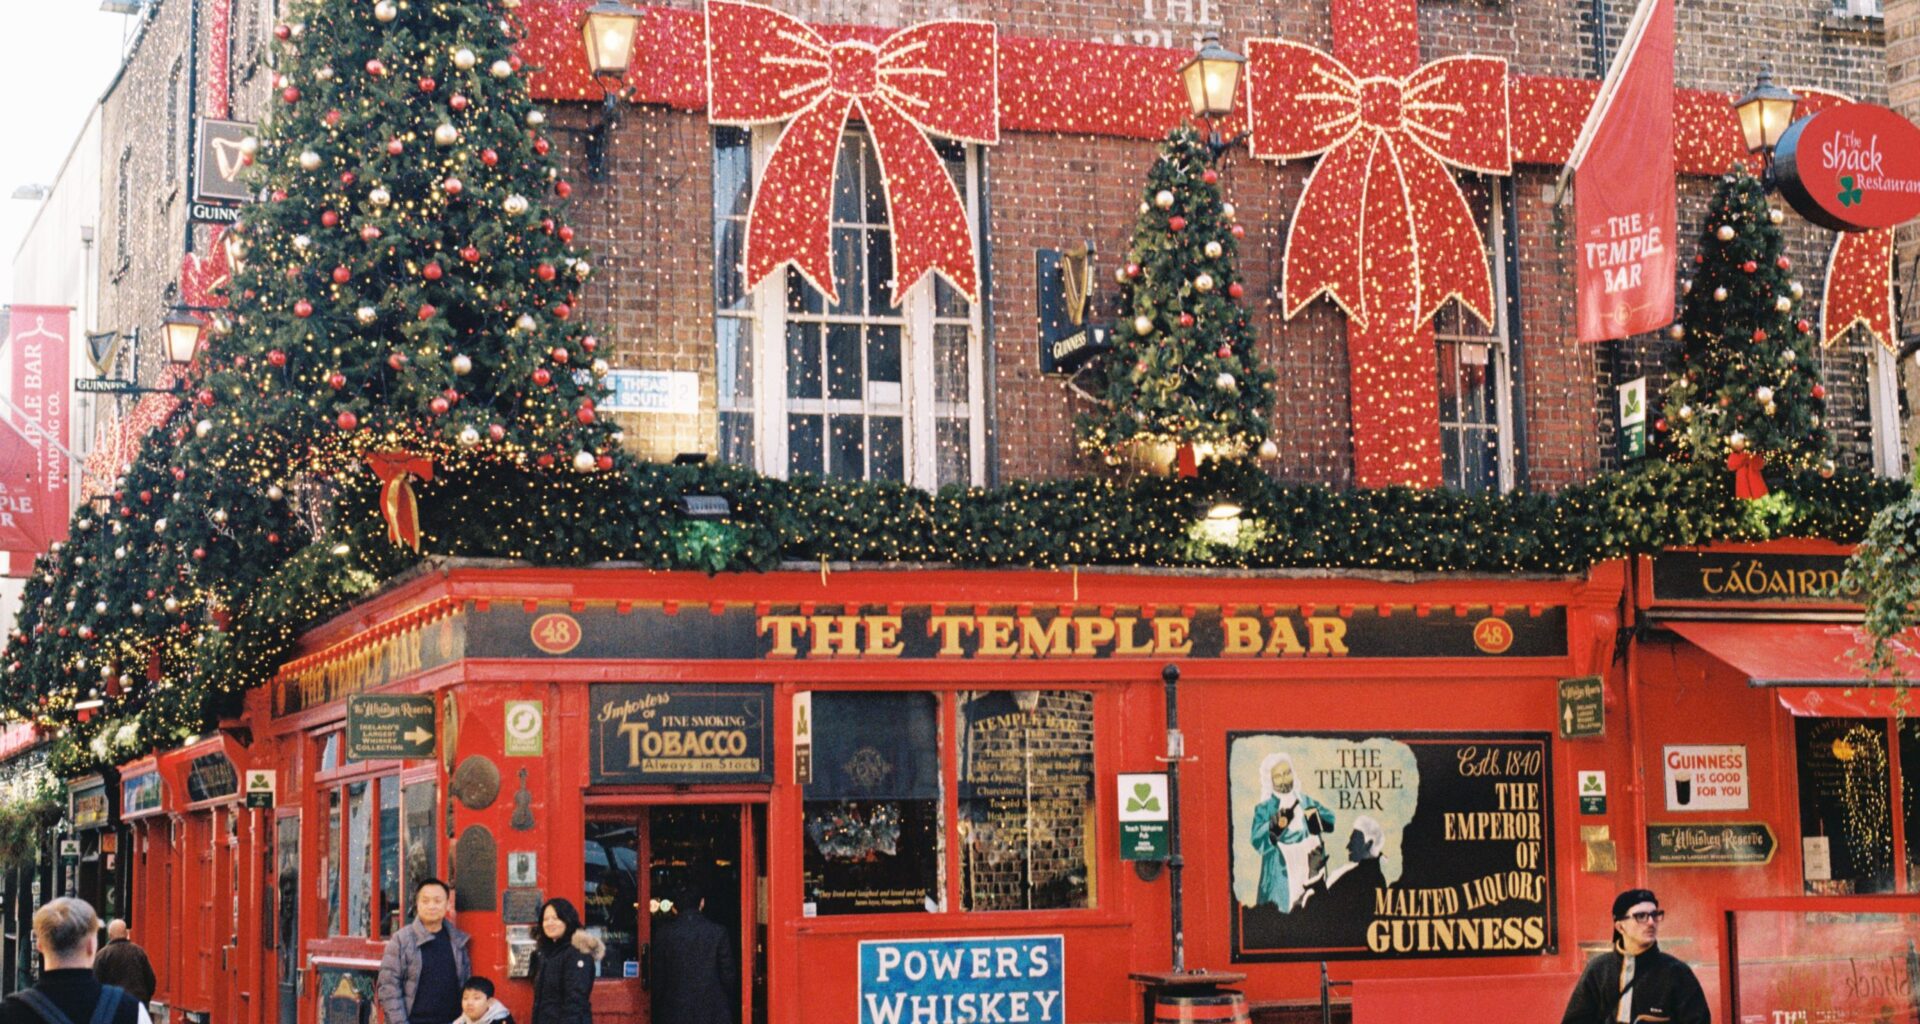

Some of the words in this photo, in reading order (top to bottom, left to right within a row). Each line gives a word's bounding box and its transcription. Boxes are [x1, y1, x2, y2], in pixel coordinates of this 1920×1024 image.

[1842, 130, 1861, 148] The
[1822, 130, 1884, 177] Shack
[1856, 173, 1920, 193] Restauran
[193, 204, 239, 220] GUINN
[1608, 213, 1642, 238] THE
[1585, 226, 1664, 269] TEMPLE
[1603, 263, 1641, 294] BAR
[24, 343, 42, 389] BAR
[541, 621, 569, 643] 48
[759, 616, 905, 656] THE
[929, 616, 1193, 656] TEMPLE
[1222, 617, 1349, 656] BAR
[1481, 625, 1503, 645] 48
[300, 667, 324, 709] THE
[330, 644, 382, 701] TEMPLE
[390, 630, 421, 677] BAR
[597, 692, 670, 722] Importers
[662, 716, 689, 727] FINE
[691, 716, 745, 727] SMOKING
[645, 759, 692, 771] Always
[701, 759, 712, 769] in
[720, 759, 757, 769] Stock
[1336, 749, 1382, 768] THE
[1506, 751, 1540, 776] 1840
[1667, 752, 1743, 769] GUINNESS
[1315, 770, 1403, 789] TEMPLE
[1696, 773, 1706, 783] IS
[1709, 773, 1740, 783] GOOD
[1340, 790, 1384, 811] BAR
[1495, 783, 1539, 810] THE
[1697, 786, 1716, 797] FOR
[1721, 786, 1741, 797] YOU
[1444, 812, 1541, 840] EMPEROR
[1658, 832, 1672, 847] The
[1672, 828, 1720, 852] Whiskey
[1722, 828, 1763, 851] Reserve
[1516, 841, 1540, 869] OF
[1374, 887, 1459, 916] MALTED
[1462, 871, 1546, 910] LIQUORS
[1367, 916, 1545, 952] GUINNESS
[876, 945, 1049, 982] POWER'S
[864, 991, 1060, 1024] WHISKEY
